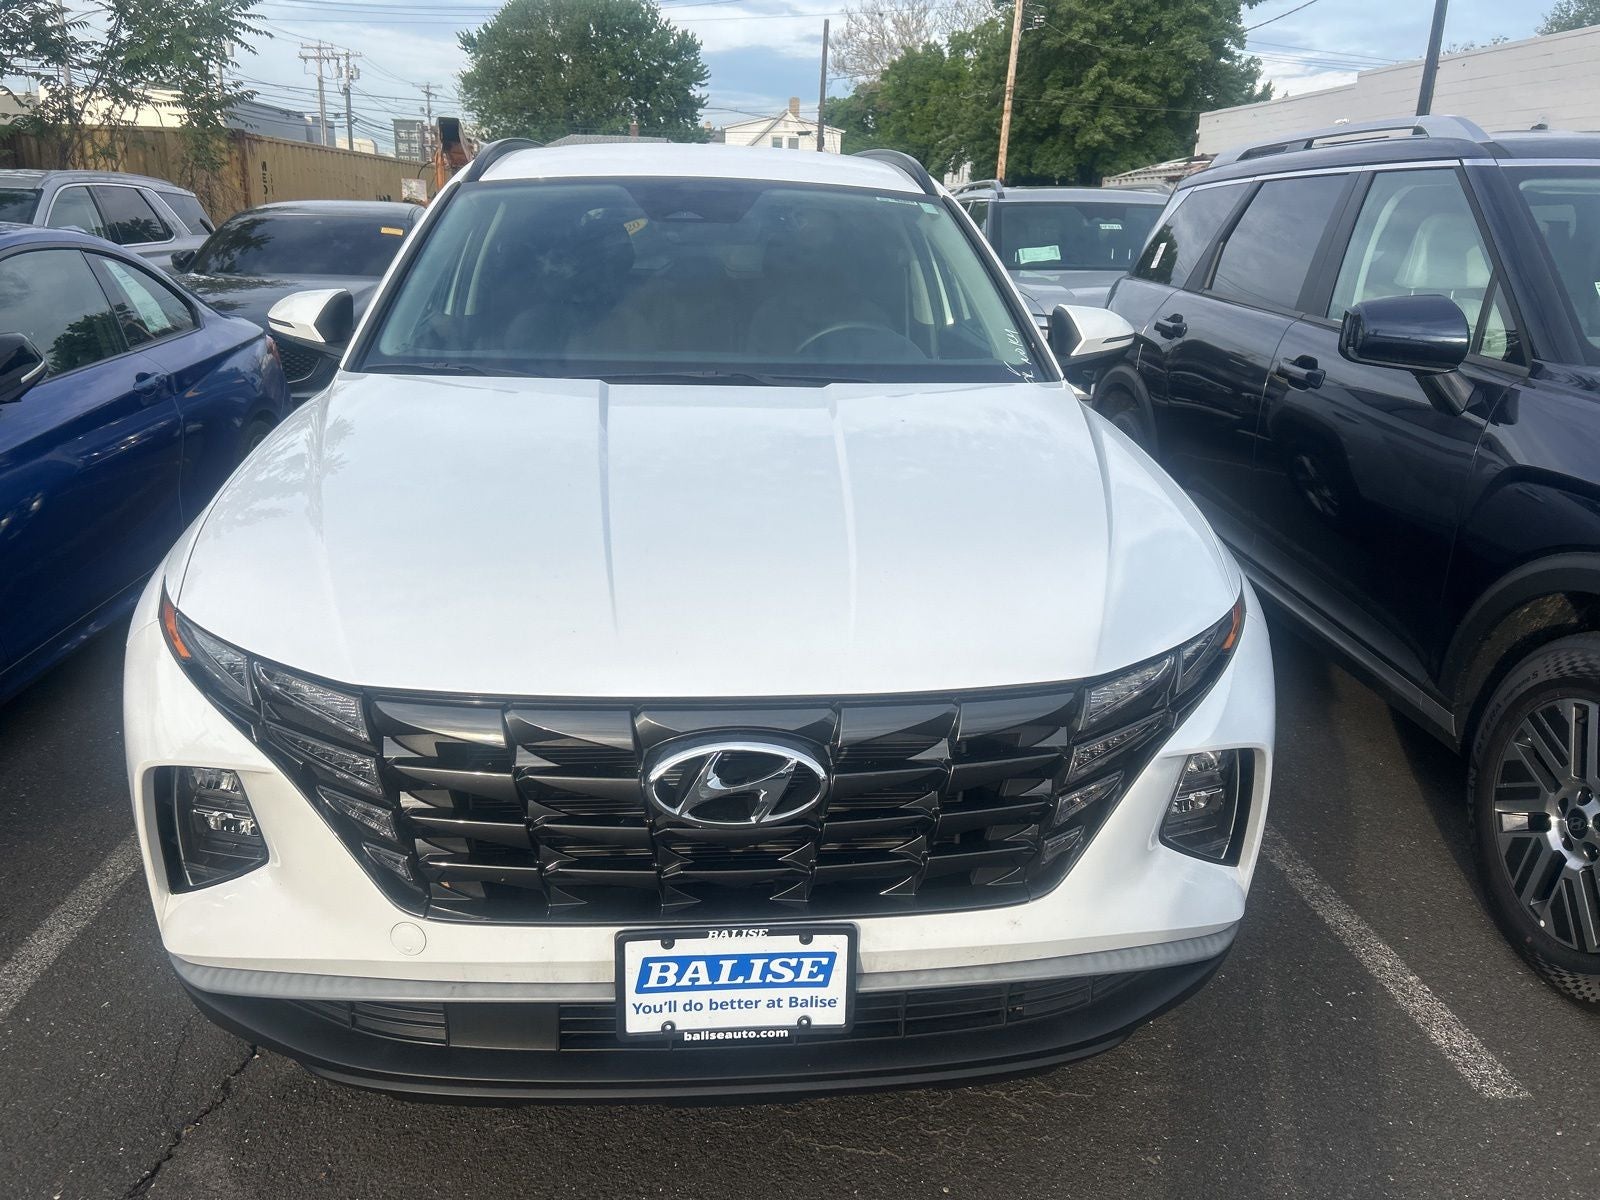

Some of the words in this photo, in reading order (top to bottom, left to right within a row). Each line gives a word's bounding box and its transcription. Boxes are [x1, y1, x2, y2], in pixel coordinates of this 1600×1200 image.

[706, 928, 769, 939] BALISE
[642, 957, 830, 988] BALISE
[632, 1001, 678, 1015] You'll
[682, 1000, 704, 1012] do
[708, 998, 761, 1011] better
[766, 997, 784, 1009] at
[788, 995, 838, 1008] Balise
[683, 1028, 789, 1042] baliseauto.com
